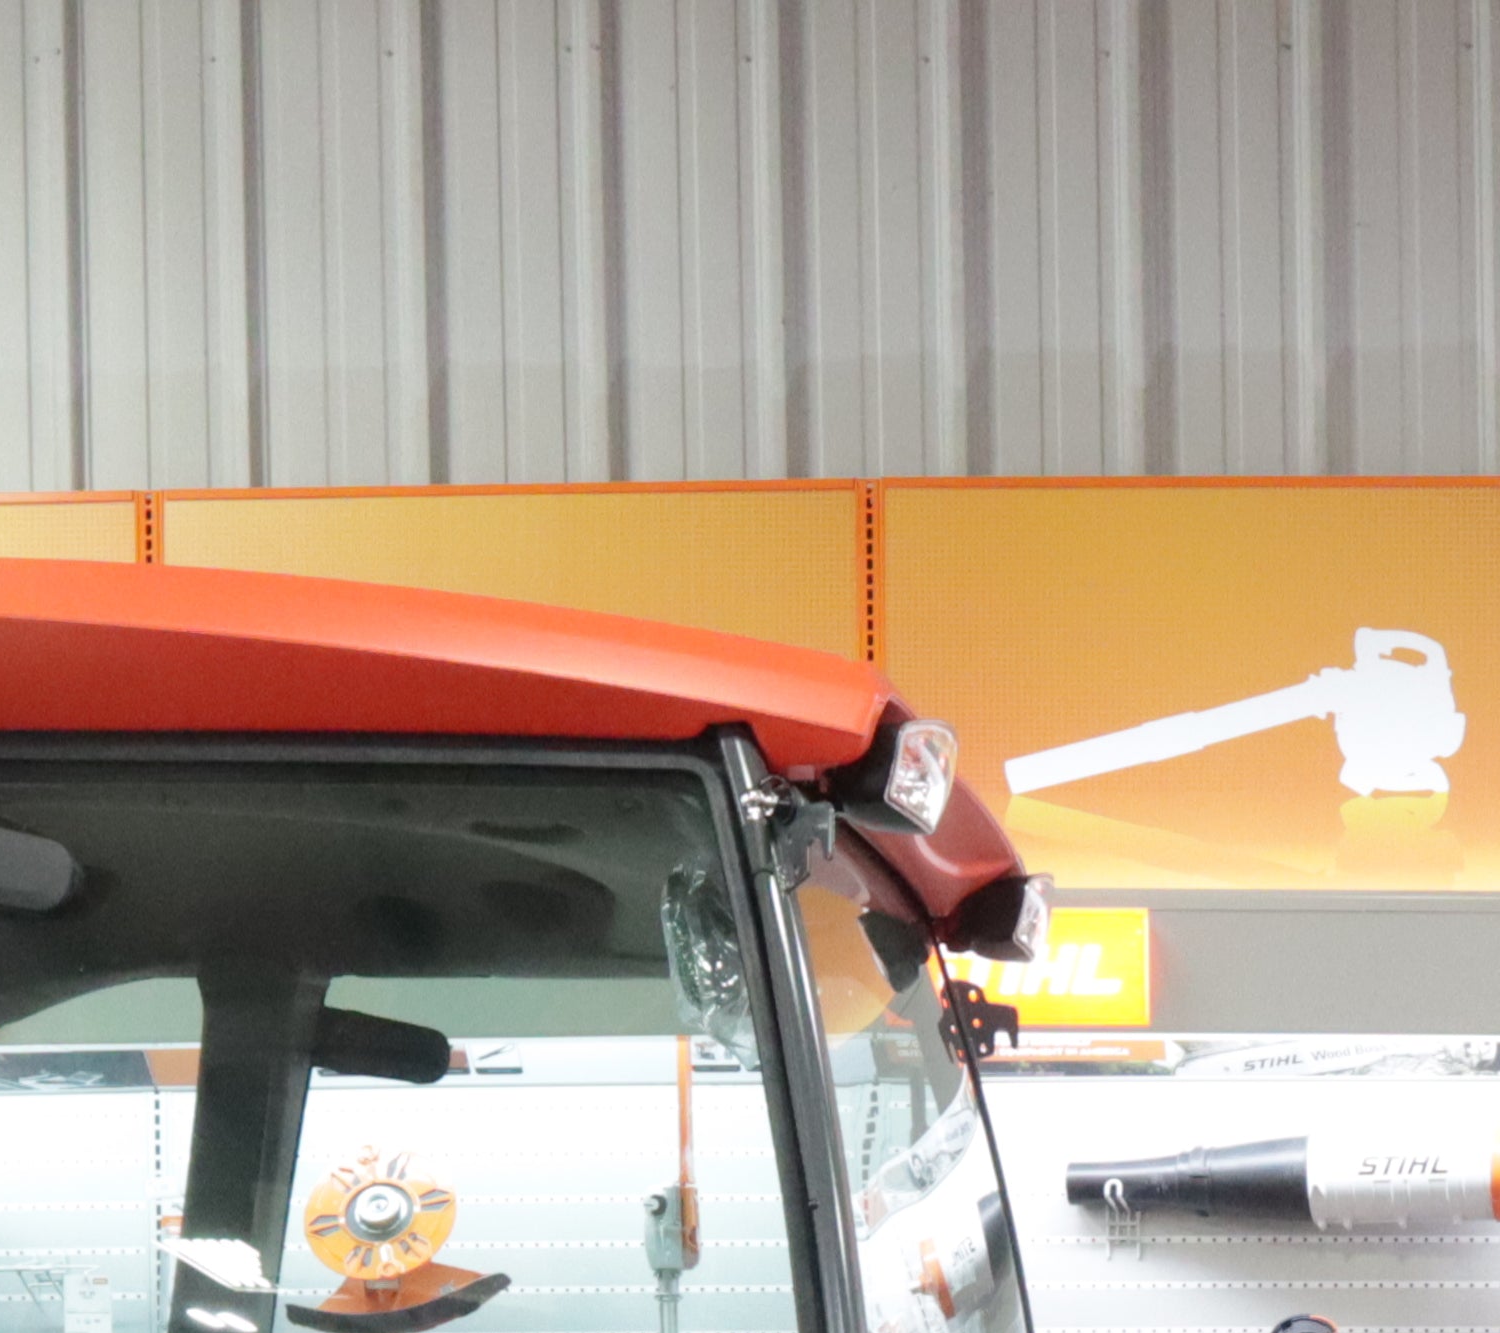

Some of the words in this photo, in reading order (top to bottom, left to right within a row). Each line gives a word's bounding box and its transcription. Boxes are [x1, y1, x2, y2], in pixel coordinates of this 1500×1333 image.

[1243, 1054, 1303, 1072] STIHL
[1311, 1049, 1352, 1062] Wood
[1358, 1154, 1448, 1175] STIHL
